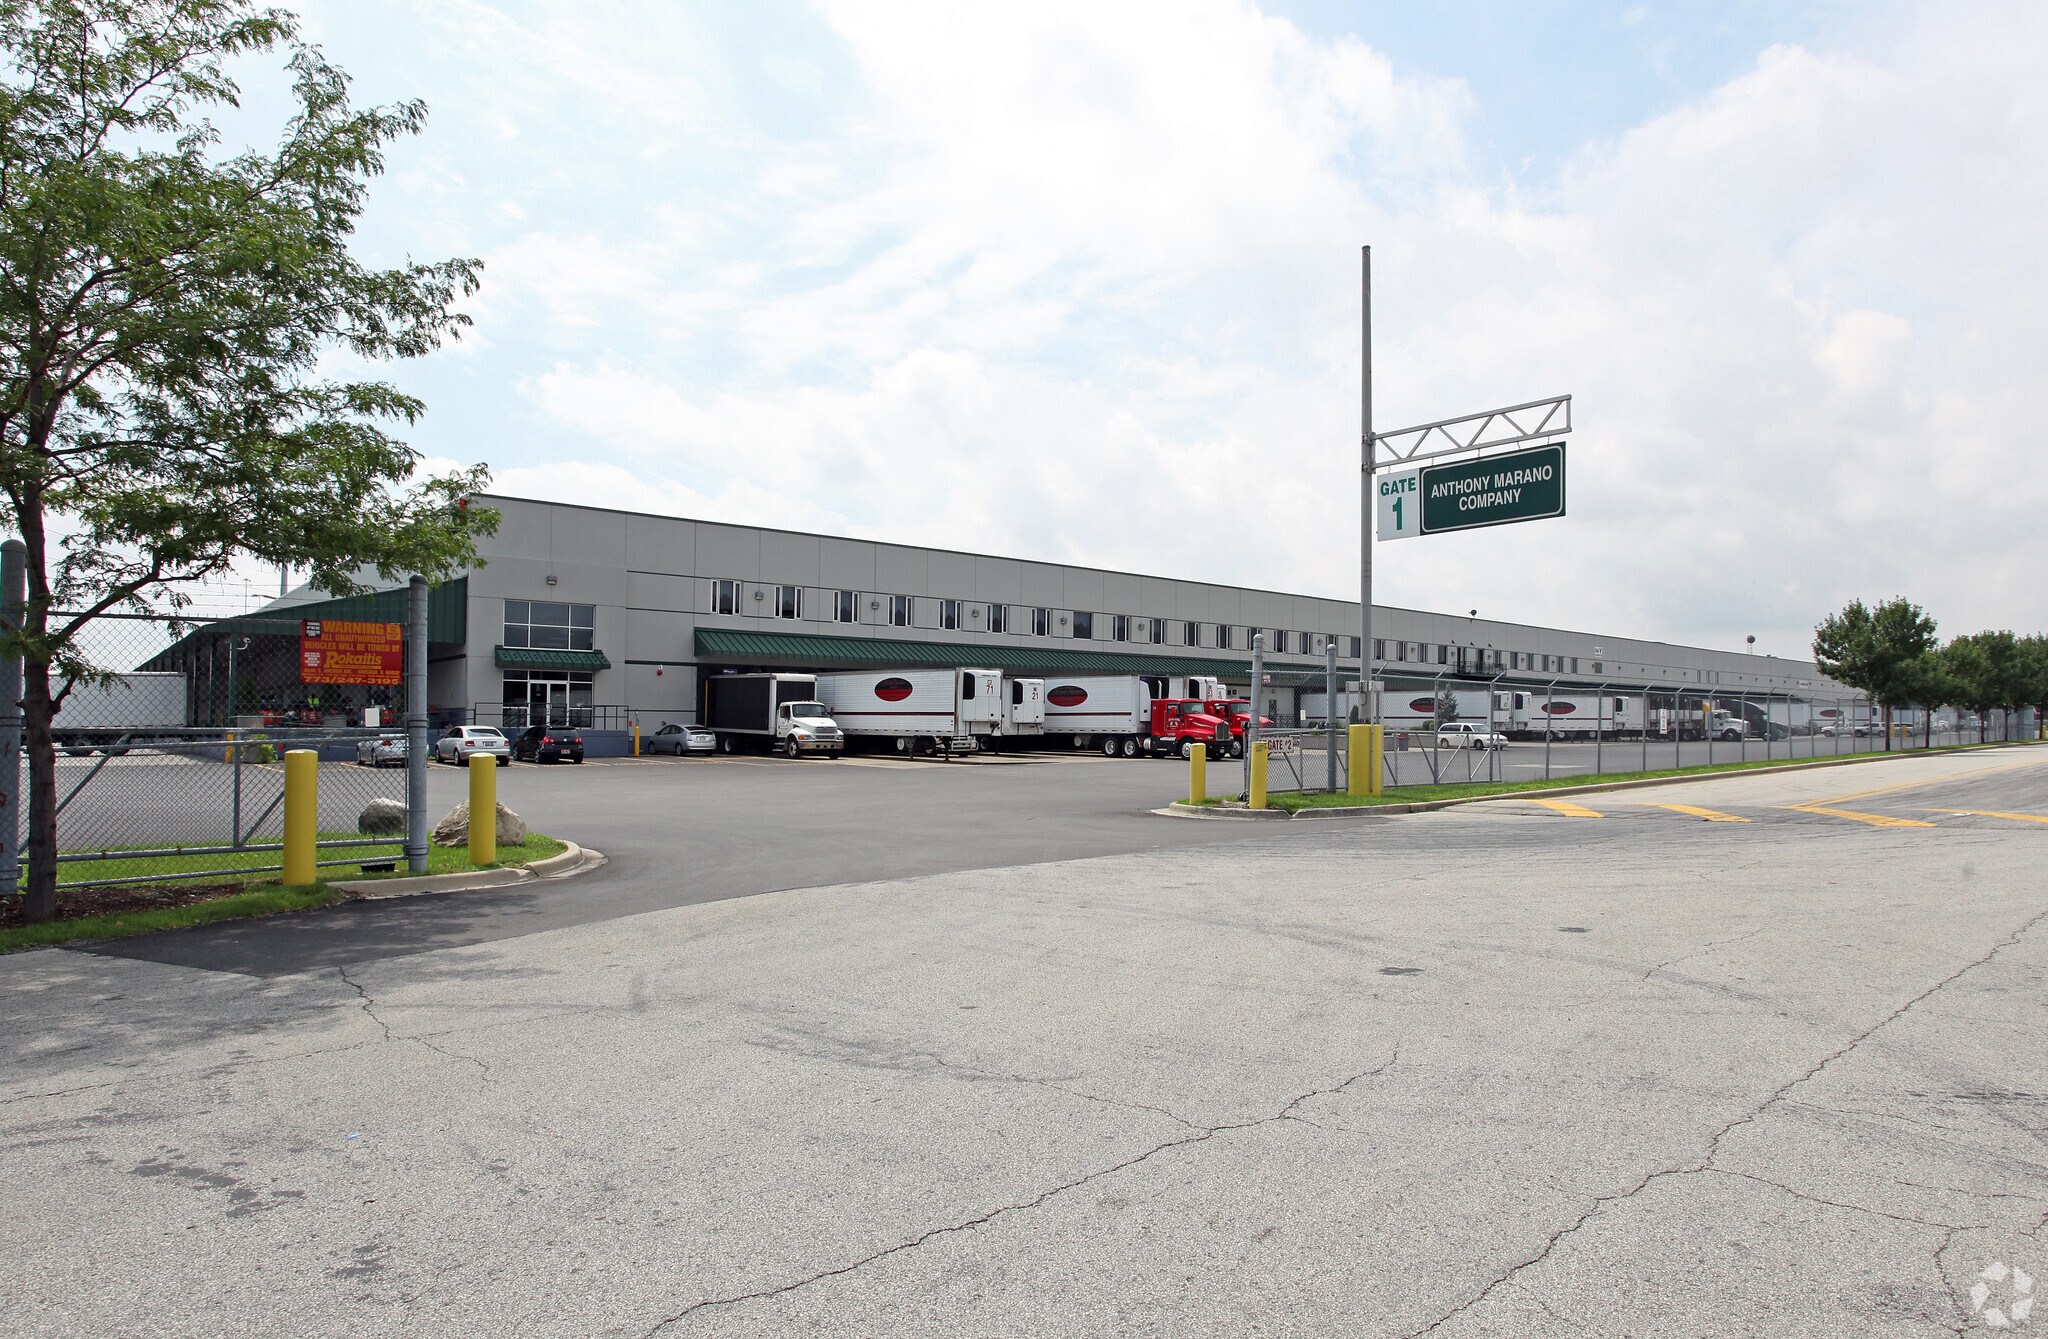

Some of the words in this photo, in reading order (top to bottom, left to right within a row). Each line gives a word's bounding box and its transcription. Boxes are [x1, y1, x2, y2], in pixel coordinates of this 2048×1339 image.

[1380, 477, 1417, 496] GATE
[1431, 475, 1490, 498] ANTHONY
[1494, 465, 1553, 487] MARANO
[1459, 488, 1522, 511] COMPANY
[1392, 497, 1403, 530] 1
[322, 620, 384, 635] WARNING
[321, 633, 334, 641] ALL
[335, 634, 385, 643] UNAUTHORIZED
[304, 641, 337, 650] VEHICLES
[339, 643, 355, 651] WILL
[357, 643, 365, 651] BE
[368, 644, 390, 652] TOWED
[391, 644, 400, 652] BY
[323, 651, 382, 668] Rokaitis
[303, 676, 400, 685] 773/247-3195
[1032, 692, 1039, 700] 21
[1267, 739, 1283, 750] GATE
